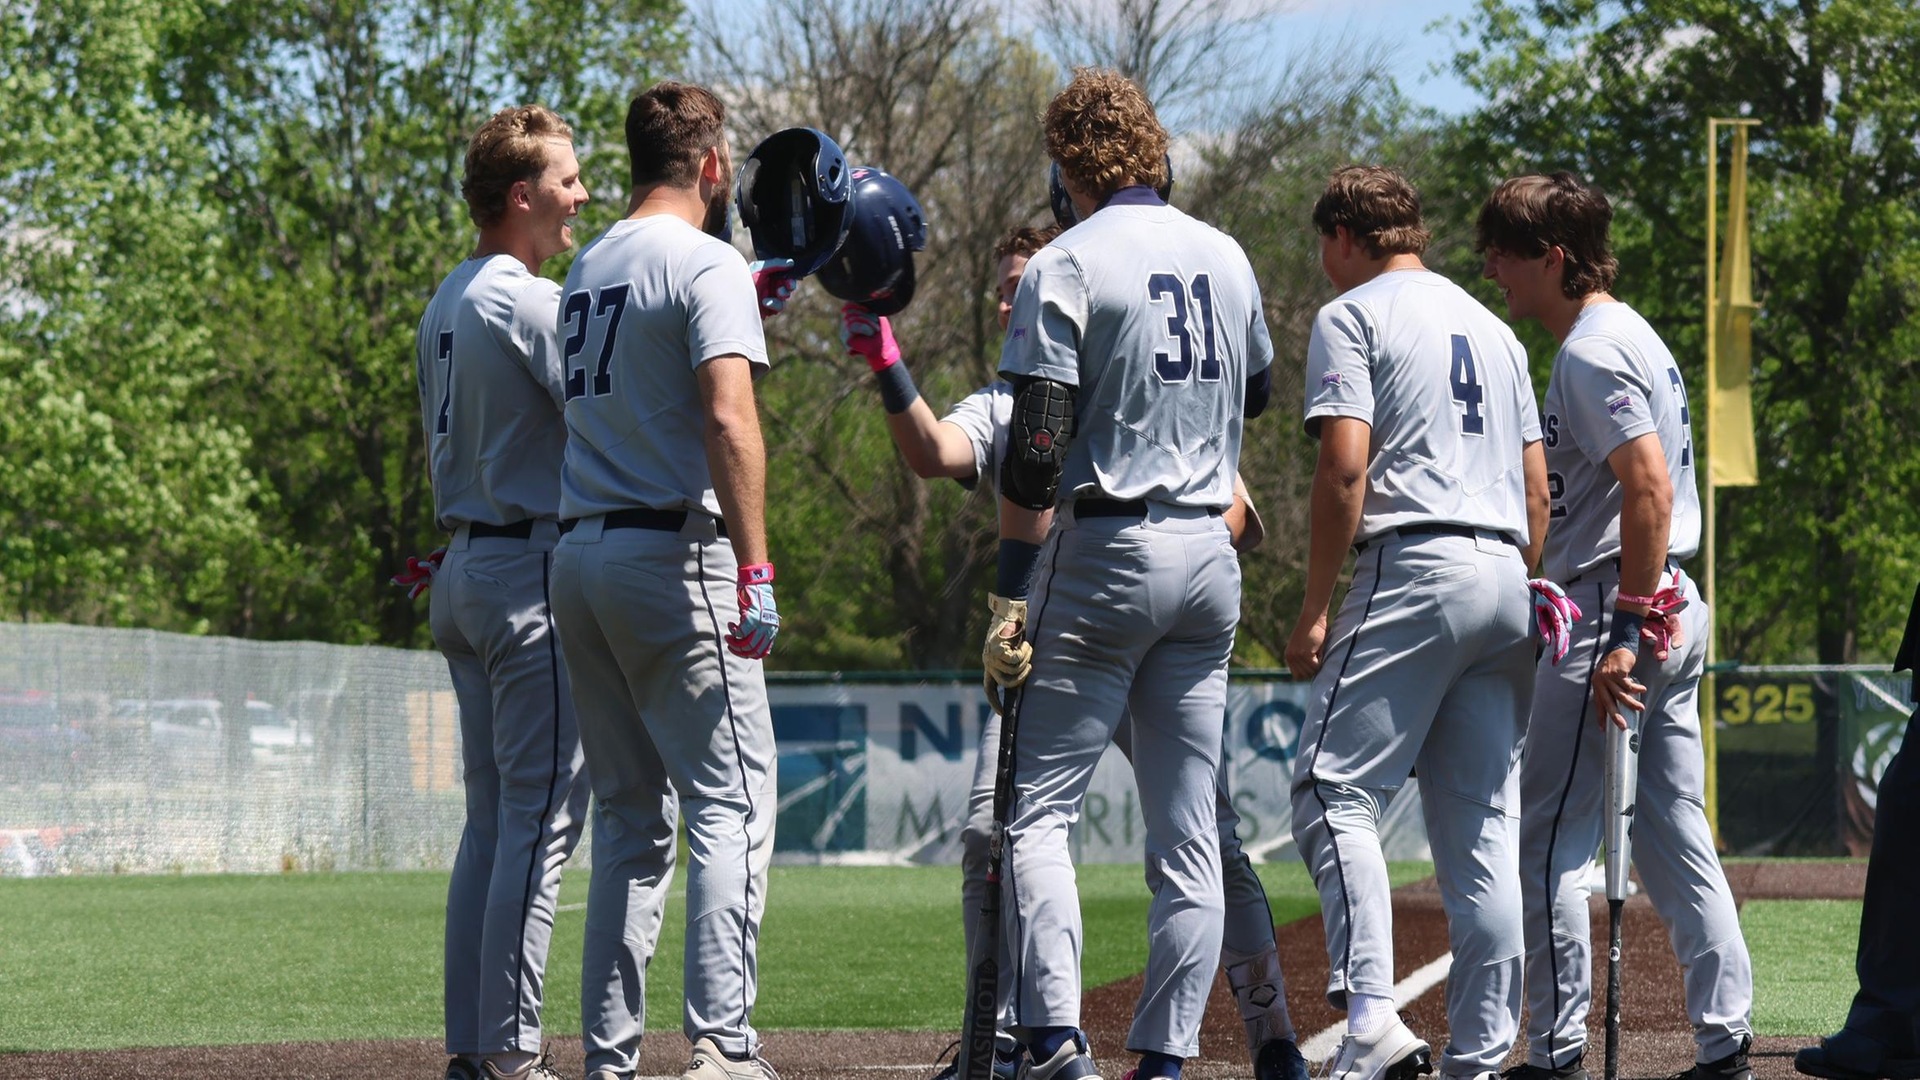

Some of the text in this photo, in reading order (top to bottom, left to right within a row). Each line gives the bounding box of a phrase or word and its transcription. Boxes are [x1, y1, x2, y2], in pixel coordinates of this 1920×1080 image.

[563, 283, 631, 403] 27
[1147, 272, 1221, 384] 31
[437, 330, 455, 436] 7
[1449, 333, 1485, 437] 4
[1721, 684, 1815, 725] 325
[971, 977, 996, 1080] LOUISVI
